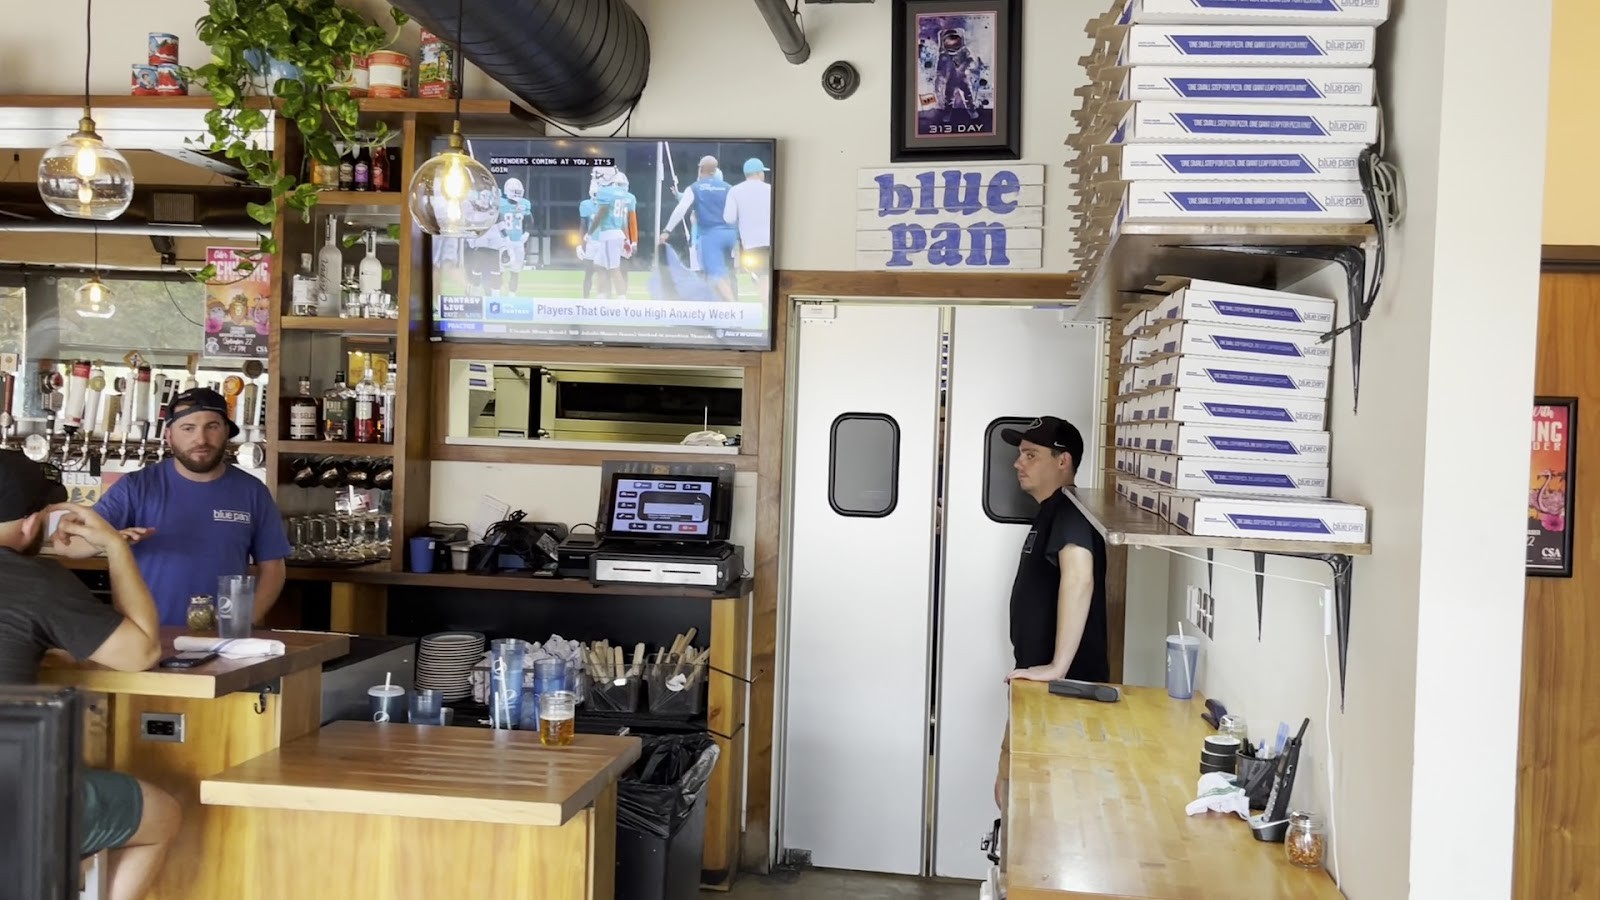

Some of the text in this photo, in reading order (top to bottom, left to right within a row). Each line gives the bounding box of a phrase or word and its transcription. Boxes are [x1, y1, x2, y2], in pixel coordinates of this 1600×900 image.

[928, 124, 984, 133] 313 DAY
[874, 170, 1021, 217] blue
[886, 221, 1010, 267] pan
[444, 296, 480, 304] FANTASY
[537, 304, 744, 320] Players That Give You High Anxiety Week 1
[213, 510, 249, 522] blue pan
[1542, 548, 1561, 558] CSA
